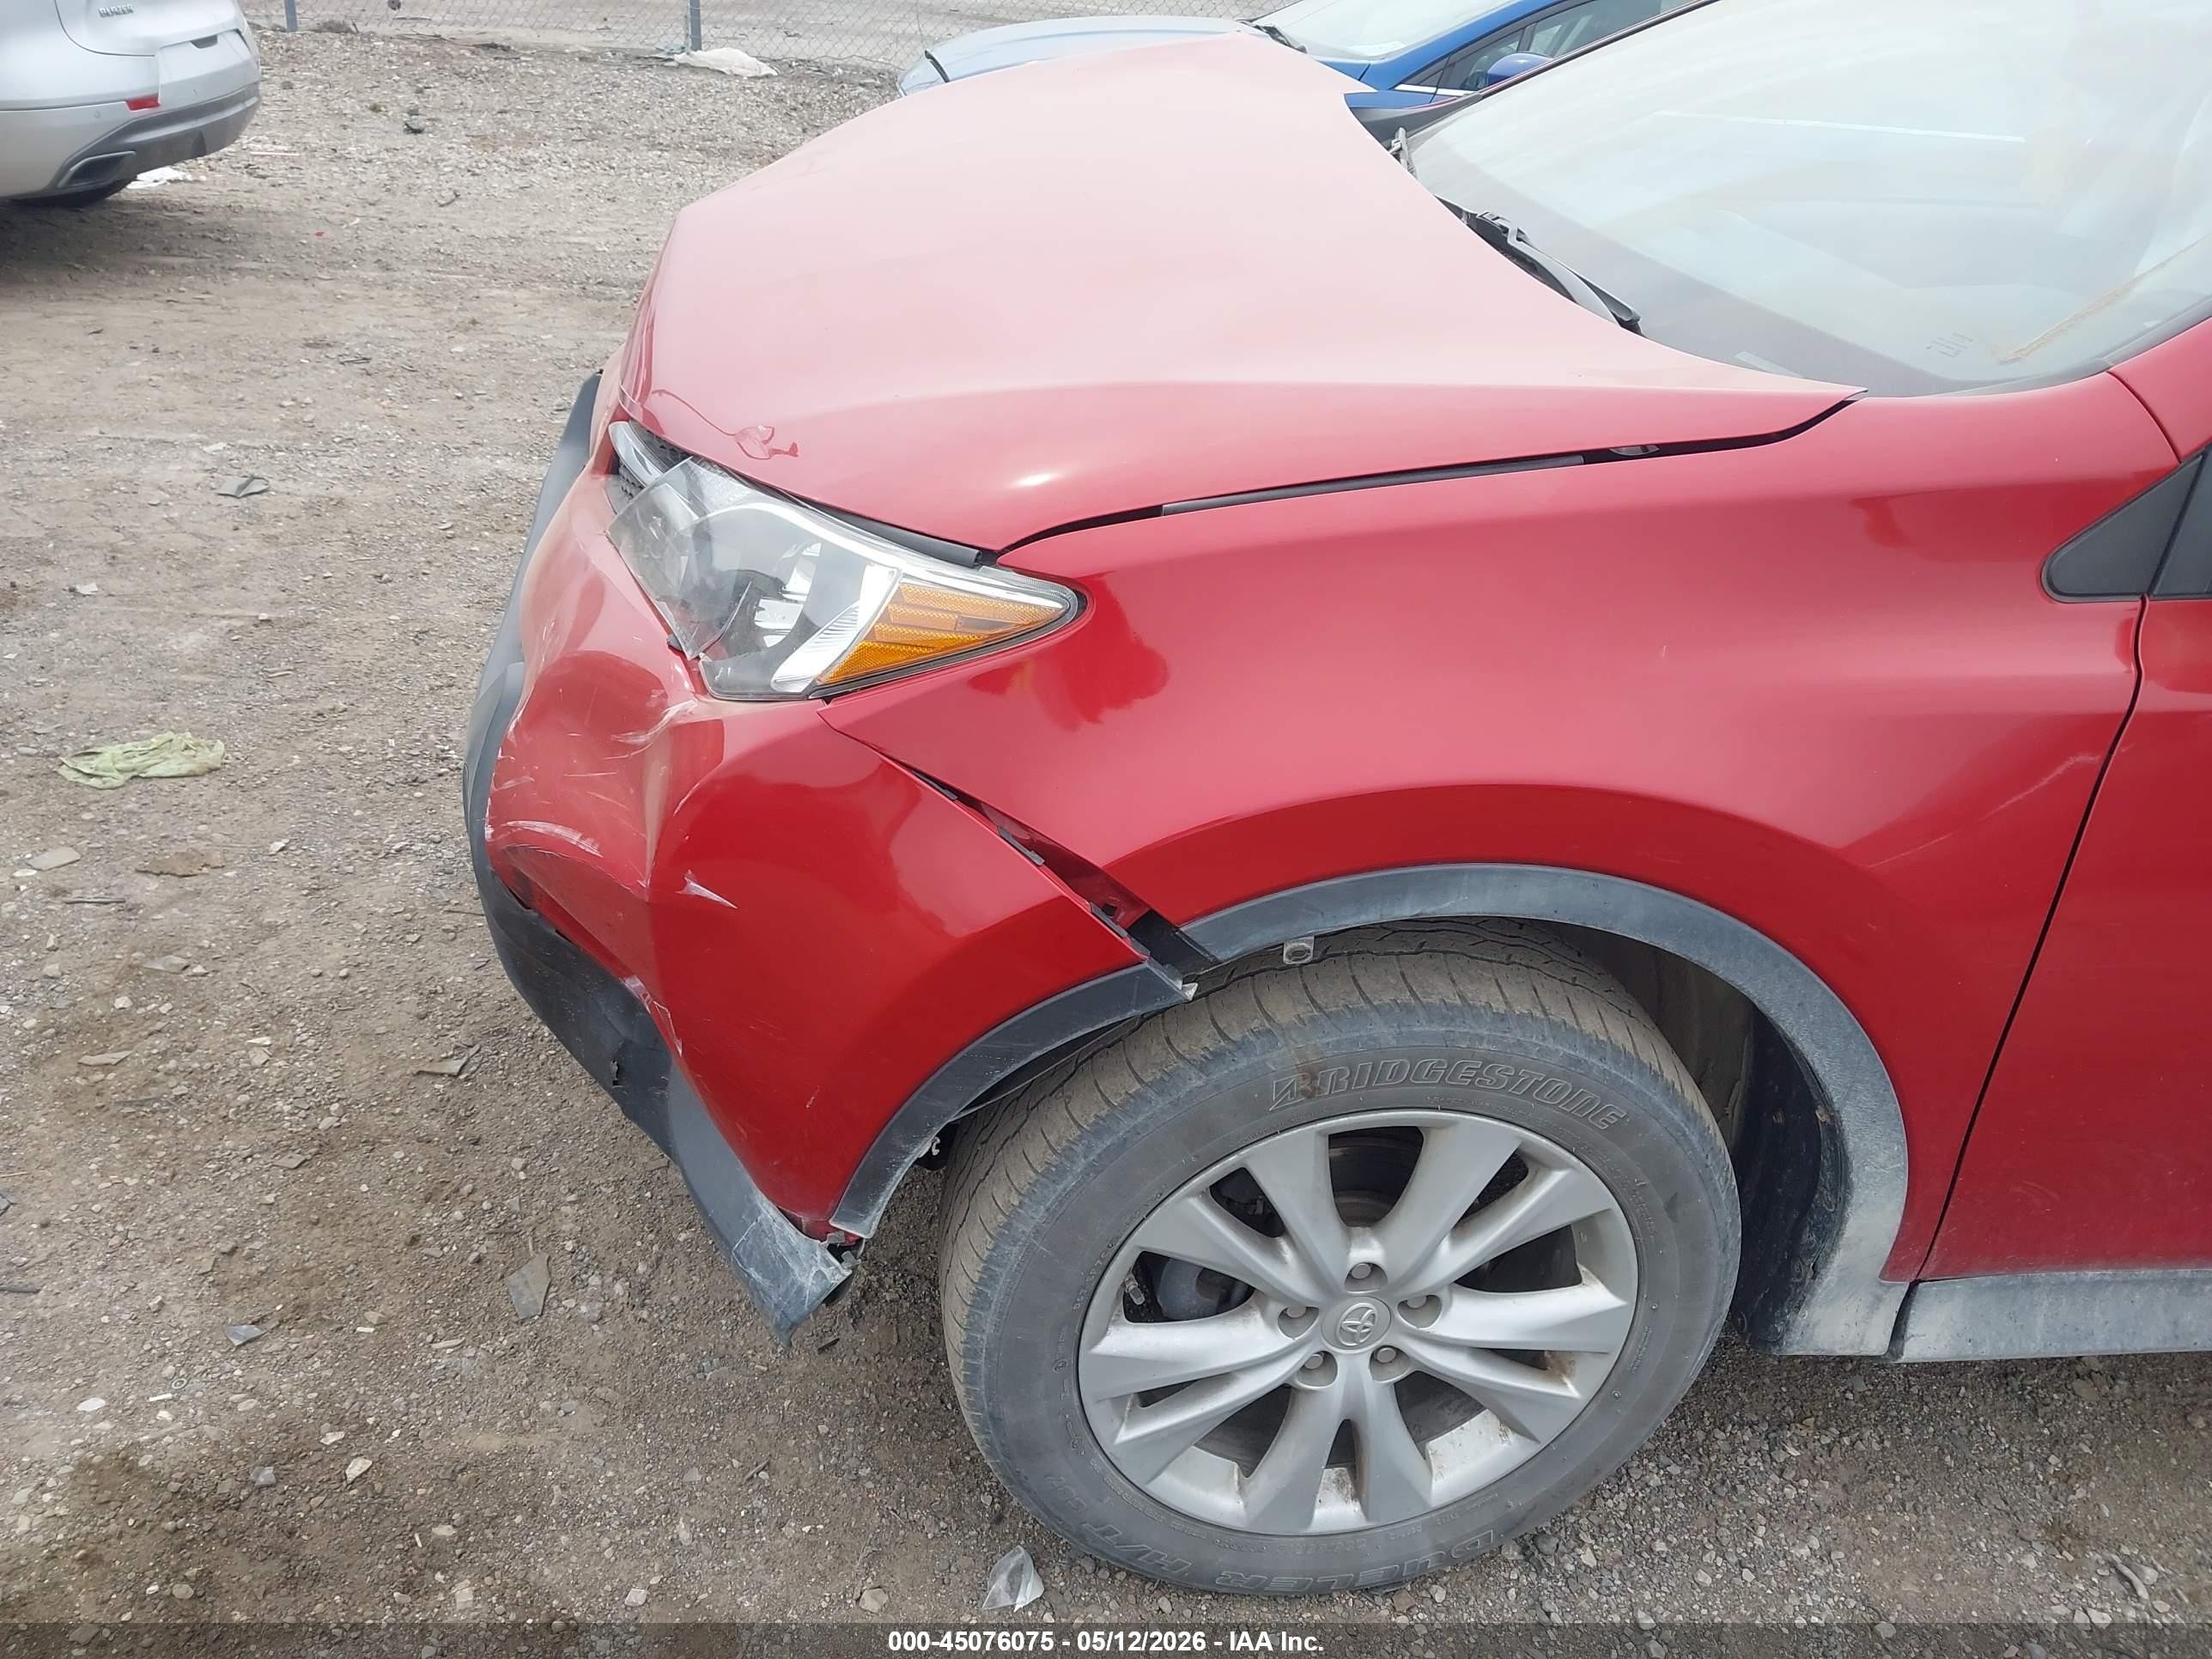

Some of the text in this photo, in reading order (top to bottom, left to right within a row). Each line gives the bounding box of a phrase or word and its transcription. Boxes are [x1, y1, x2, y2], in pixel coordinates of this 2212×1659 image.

[98, 3, 134, 18] BLAZER
[1268, 1058, 1627, 1130] BRIDGESTONE
[1081, 1522, 1193, 1575] H/T
[1215, 1529, 1494, 1591] DUELER
